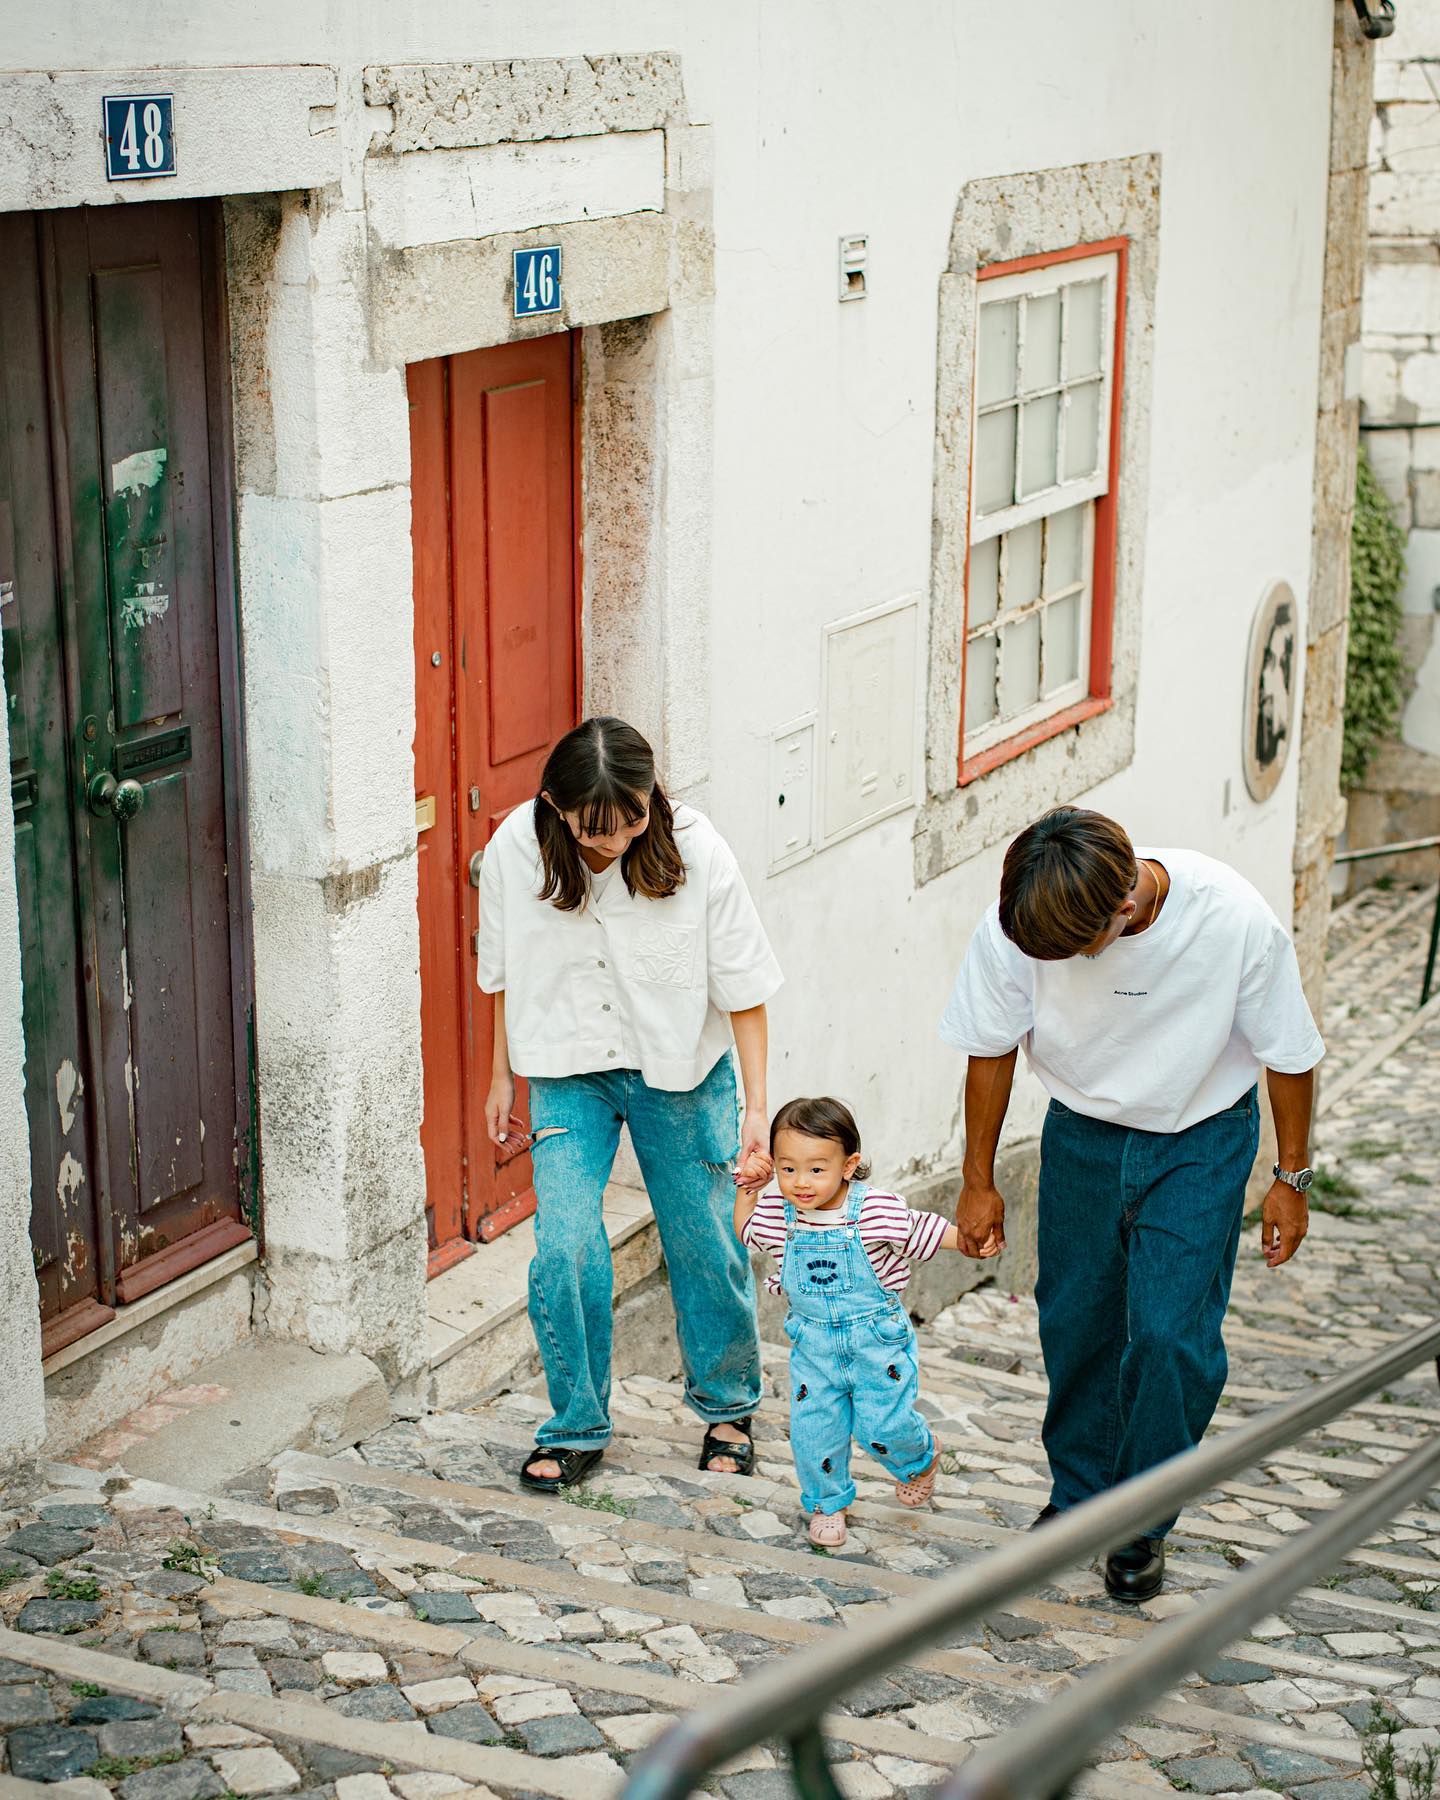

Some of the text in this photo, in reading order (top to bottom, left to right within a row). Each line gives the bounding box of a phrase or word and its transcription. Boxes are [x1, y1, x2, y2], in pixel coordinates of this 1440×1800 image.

[120, 103, 163, 170] 48
[523, 254, 553, 308] 46
[810, 1273, 838, 1285] MOUSE
